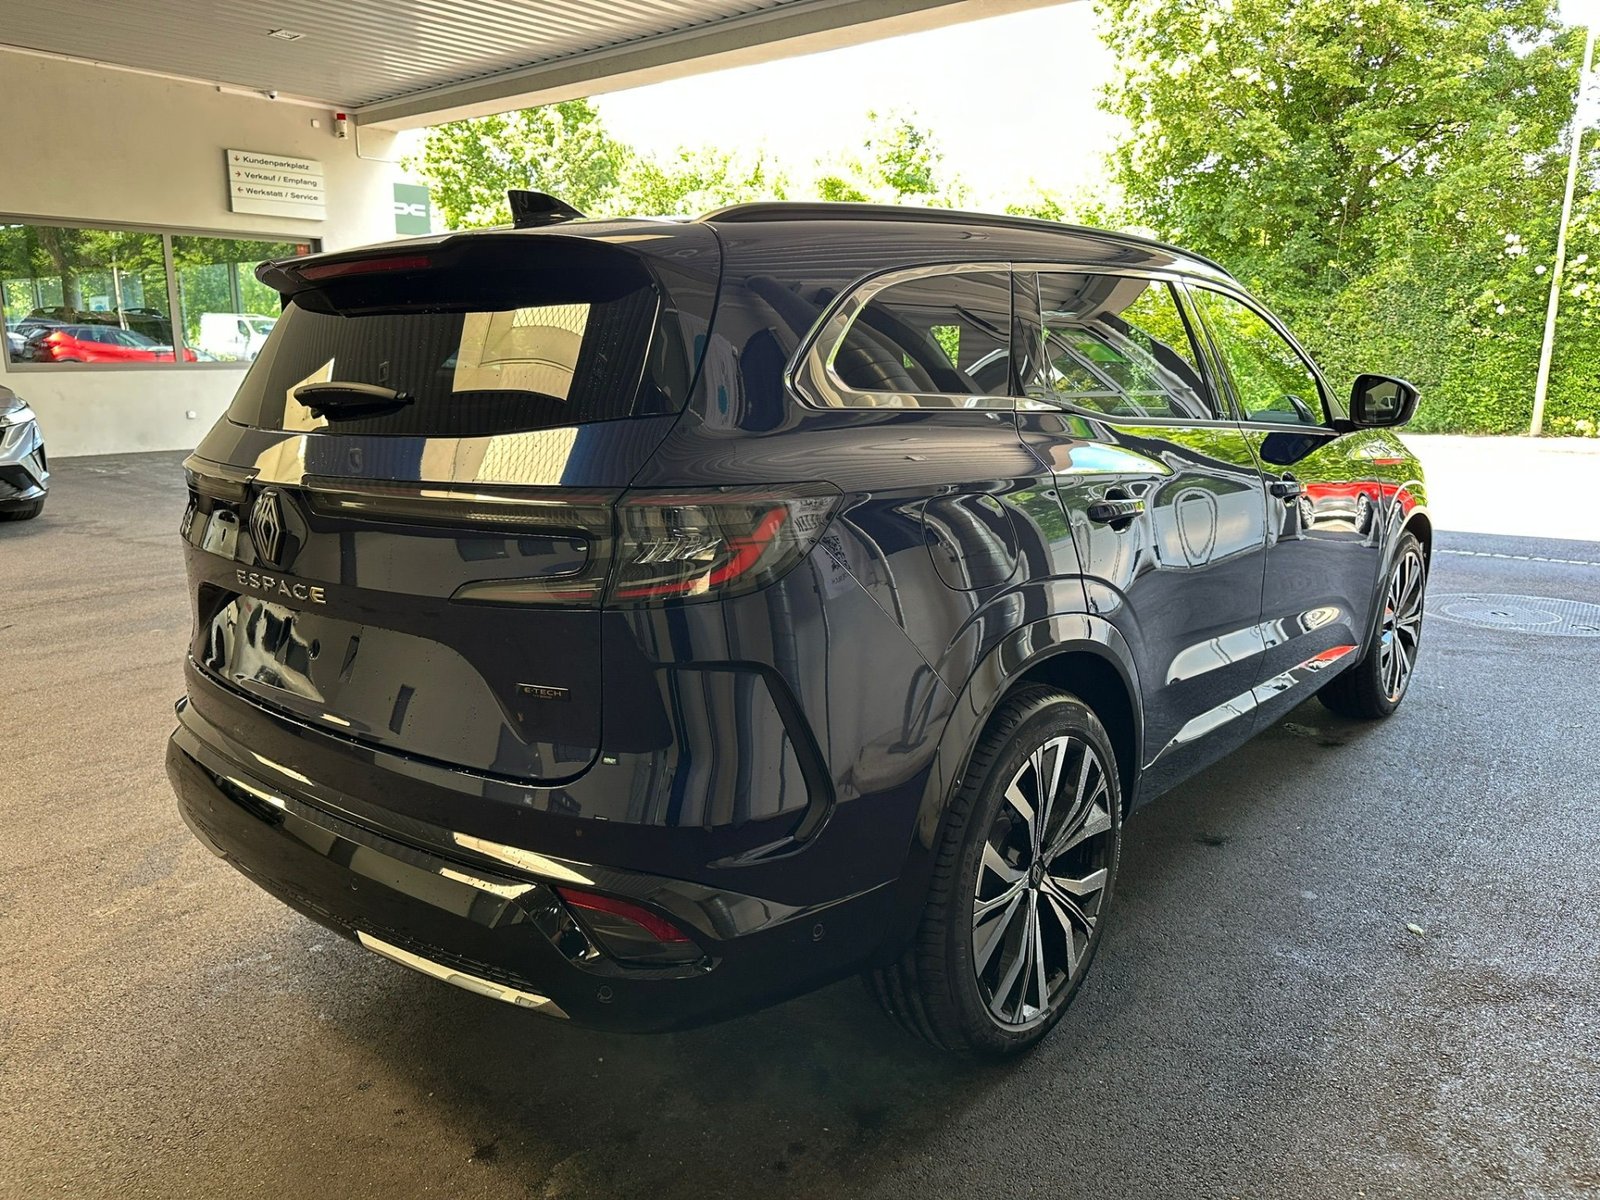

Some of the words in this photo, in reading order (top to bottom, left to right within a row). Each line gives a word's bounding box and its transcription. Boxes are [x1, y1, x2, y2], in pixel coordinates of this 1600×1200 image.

[242, 156, 310, 171] Kundenparkplatz
[244, 171, 276, 182] Verkauf
[283, 176, 318, 188] Empfang
[245, 187, 283, 198] Werkstatt
[290, 192, 319, 201] Service
[236, 569, 327, 605] ESPACE
[523, 686, 563, 697] E-TECH
